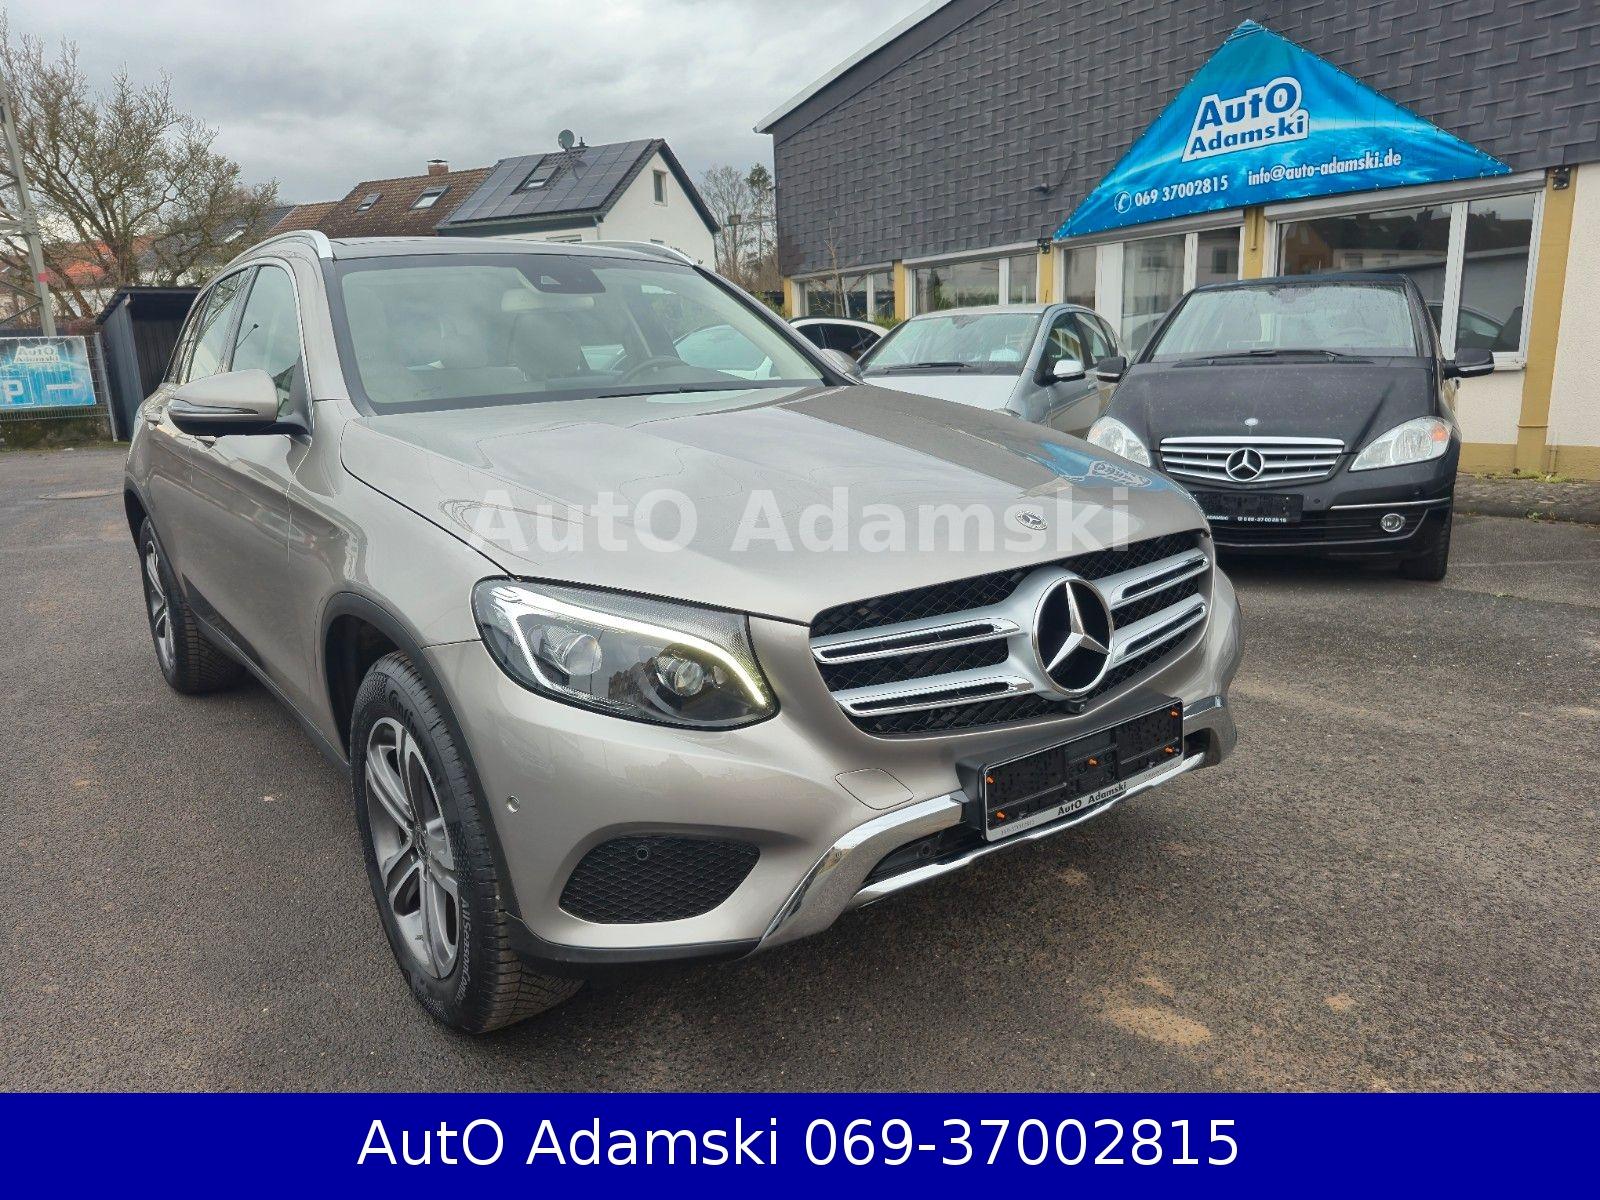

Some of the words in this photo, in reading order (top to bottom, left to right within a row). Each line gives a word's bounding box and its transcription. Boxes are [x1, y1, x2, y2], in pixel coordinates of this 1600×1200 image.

[1197, 82, 1298, 131] AutO
[1189, 115, 1304, 155] Adamski
[1247, 148, 1402, 186] info@auto-adamski.de
[1134, 190, 1158, 207] 069
[1162, 175, 1228, 202] 37002815
[4, 380, 24, 404] P
[1057, 799, 1082, 816] AutO
[1088, 781, 1127, 804] Adamski
